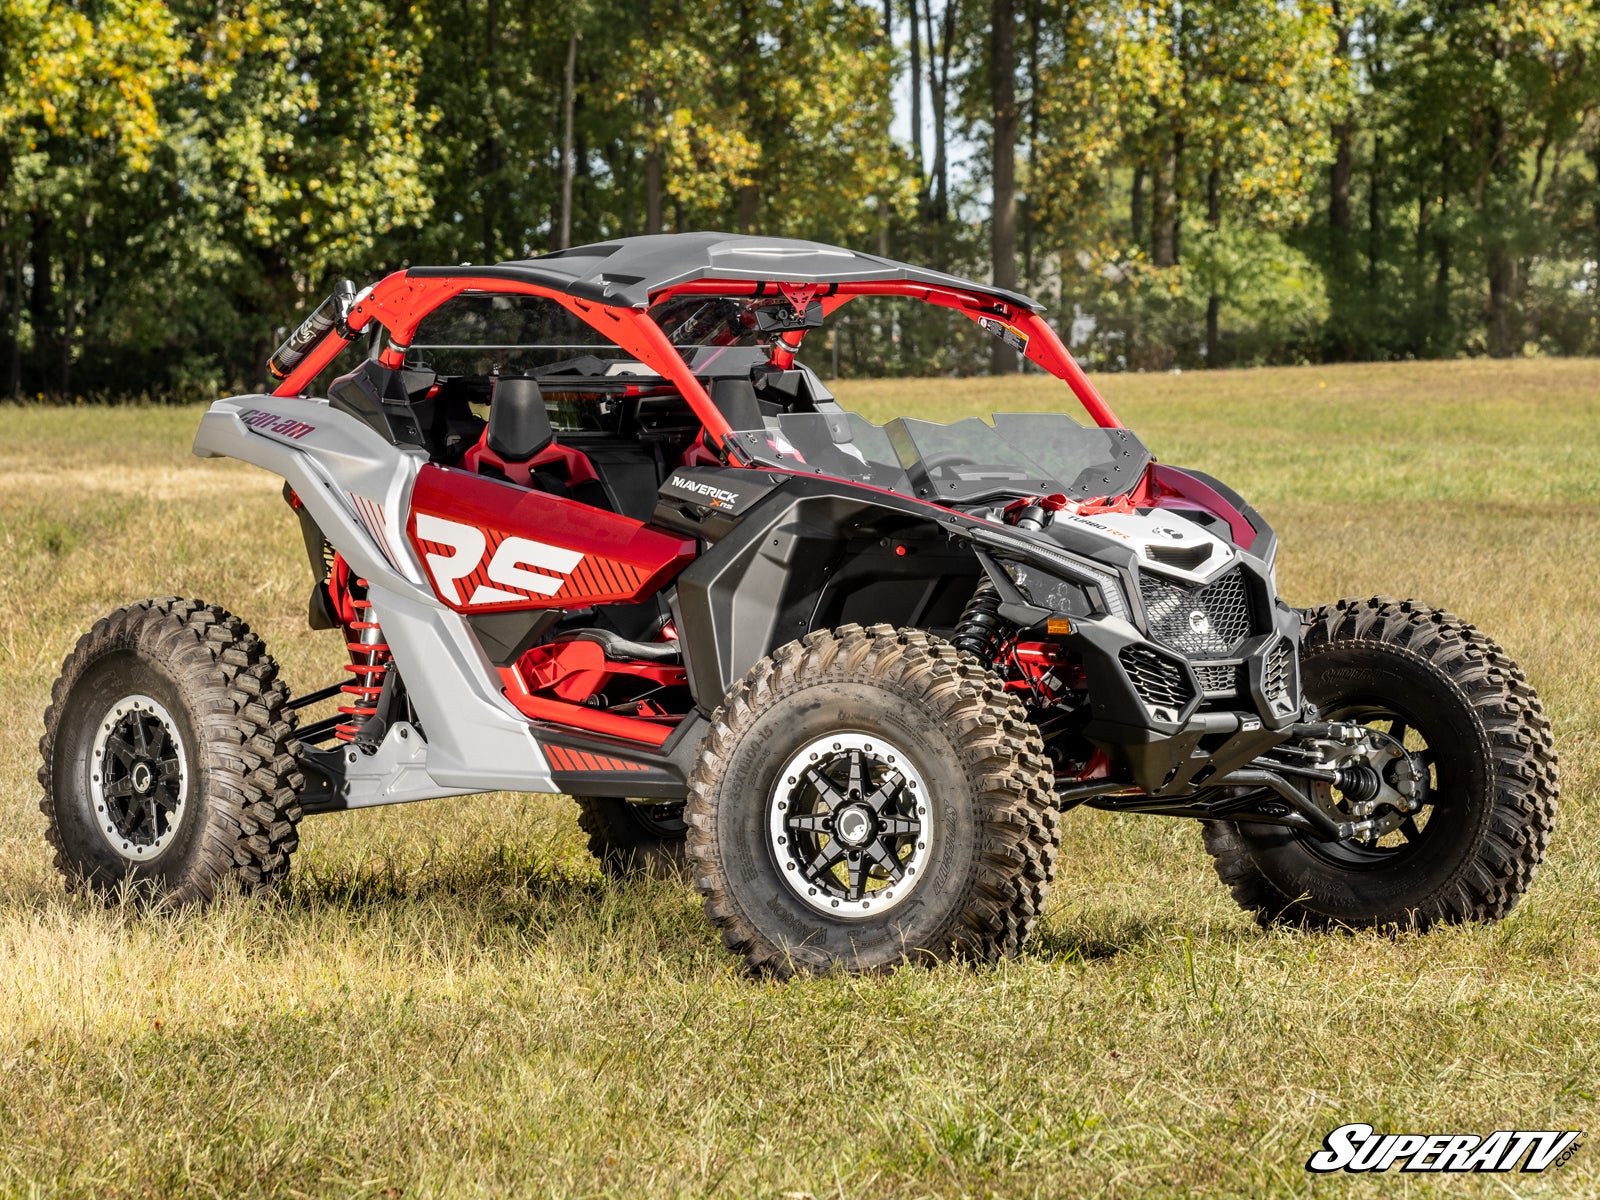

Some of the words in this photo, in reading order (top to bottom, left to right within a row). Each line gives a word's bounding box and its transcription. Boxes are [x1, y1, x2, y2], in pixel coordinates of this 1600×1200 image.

[239, 409, 316, 440] can-am
[671, 475, 739, 503] MAVERICK
[1068, 515, 1107, 530] TURBO
[1106, 528, 1131, 540] RR
[415, 512, 585, 606] RS
